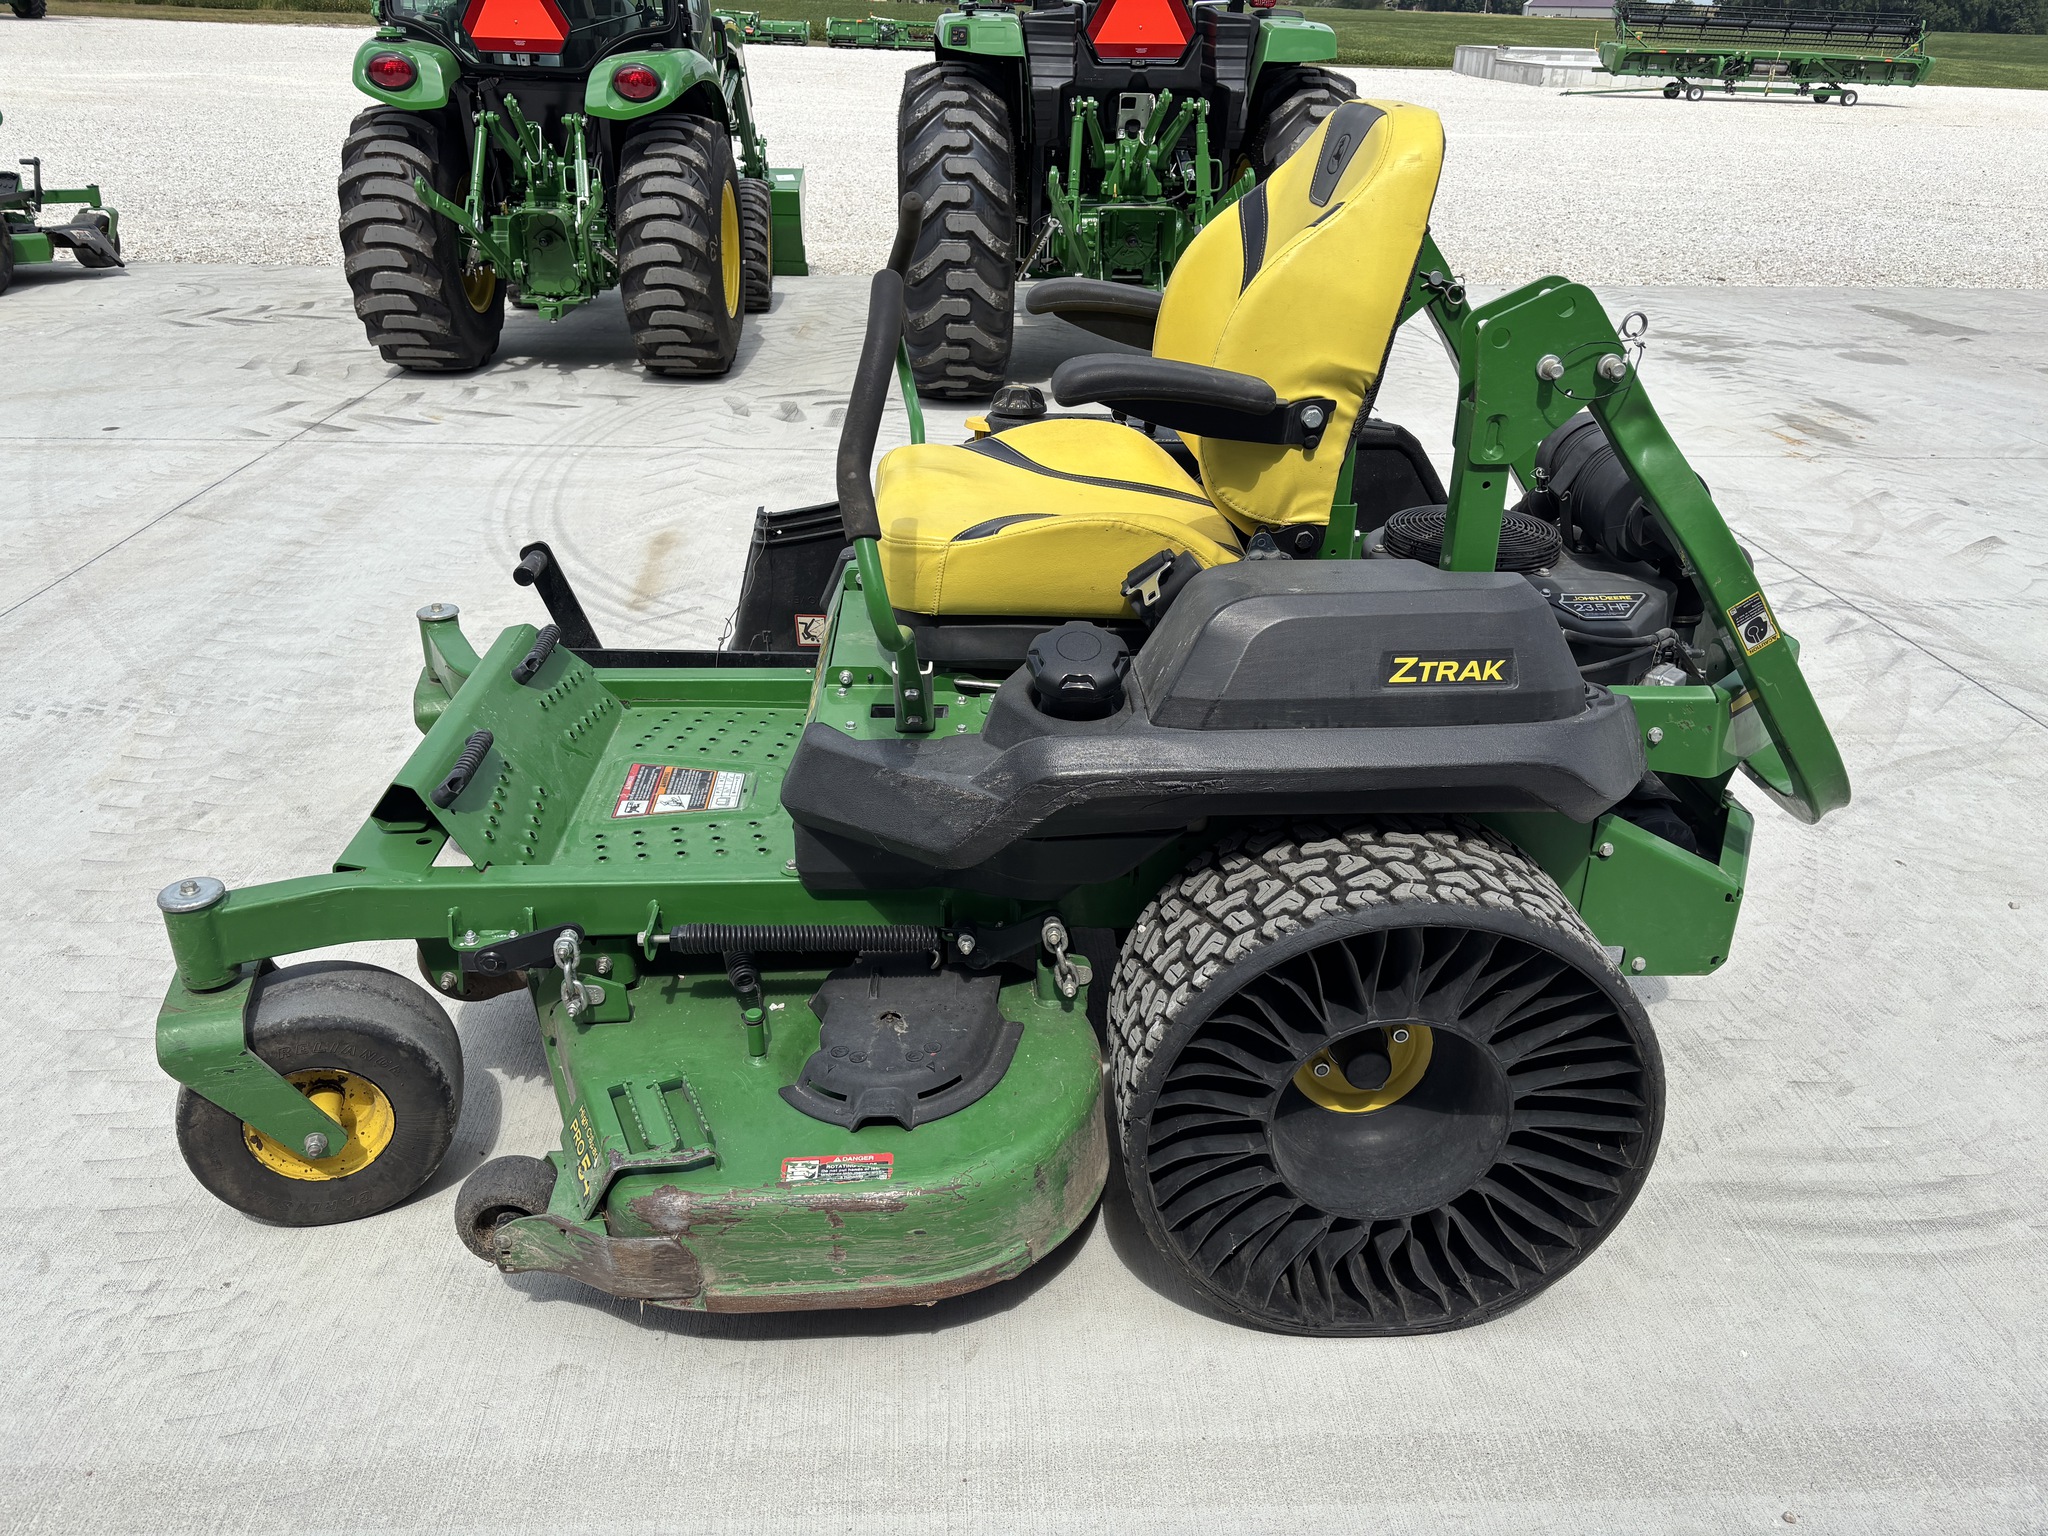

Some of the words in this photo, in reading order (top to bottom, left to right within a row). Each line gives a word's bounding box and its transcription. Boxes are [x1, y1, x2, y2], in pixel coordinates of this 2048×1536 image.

[1573, 603, 1606, 612] 23.5
[1607, 603, 1631, 611] HP
[1749, 637, 1773, 654] CAUTION
[1388, 656, 1506, 683] ZTRAK
[277, 1041, 402, 1077] RELIANCE
[569, 1117, 586, 1157] PRO
[579, 1104, 589, 1130] High
[586, 1127, 599, 1167] Capac
